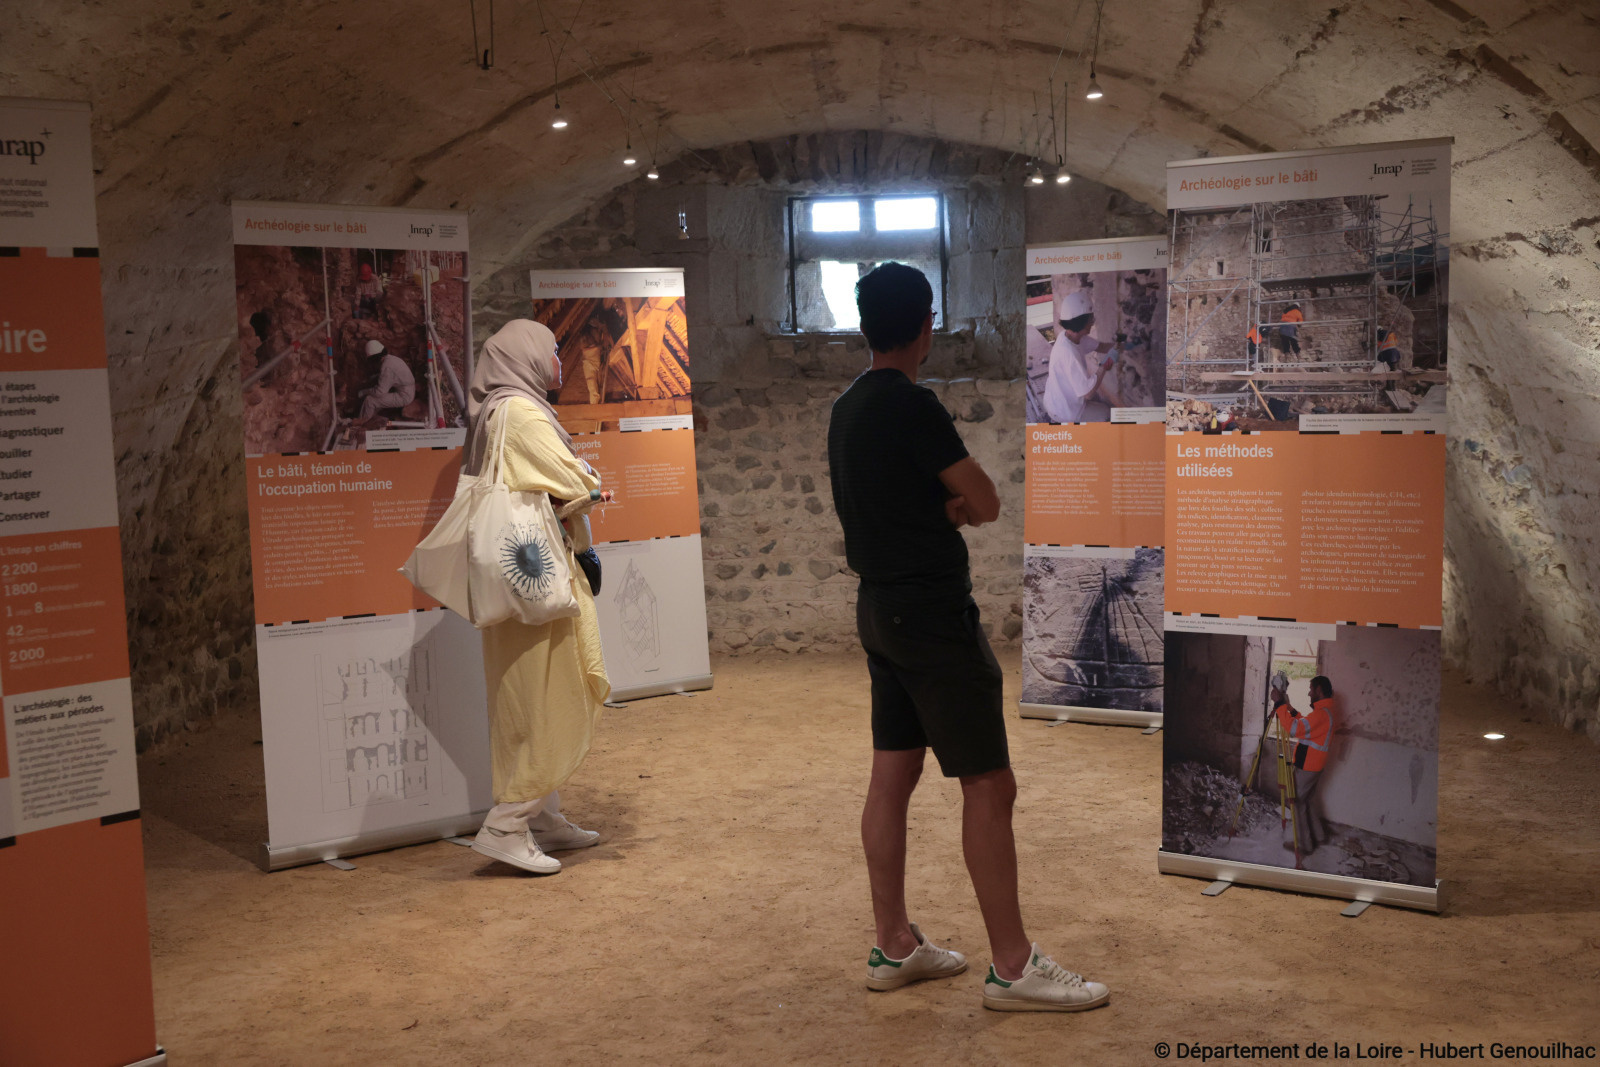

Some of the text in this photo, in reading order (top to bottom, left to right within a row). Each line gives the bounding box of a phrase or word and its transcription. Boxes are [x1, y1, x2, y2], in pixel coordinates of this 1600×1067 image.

[1373, 163, 1403, 177] Inrap
[1179, 169, 1318, 192] Archéologie sur le bâti
[245, 218, 367, 234] Archéologie sur le bâti
[410, 224, 434, 237] Inrap
[1034, 254, 1080, 265] Archéologie
[1097, 253, 1105, 261] le
[1106, 251, 1122, 260] bâti
[538, 281, 581, 291] Archéologie
[583, 281, 594, 289] sur
[595, 280, 602, 288] le
[0, 321, 48, 354] ire
[1032, 431, 1072, 443] Objectifs
[1032, 444, 1083, 454] et résultats
[1176, 443, 1273, 457] Les méthodes
[257, 461, 372, 478] Le bâti, témoin de
[1176, 462, 1233, 477] utilisées
[258, 478, 393, 498] l'occupation humaine
[6, 625, 24, 637] 42
[77, 695, 93, 703] des
[15, 704, 105, 725] métiers aux périodes
